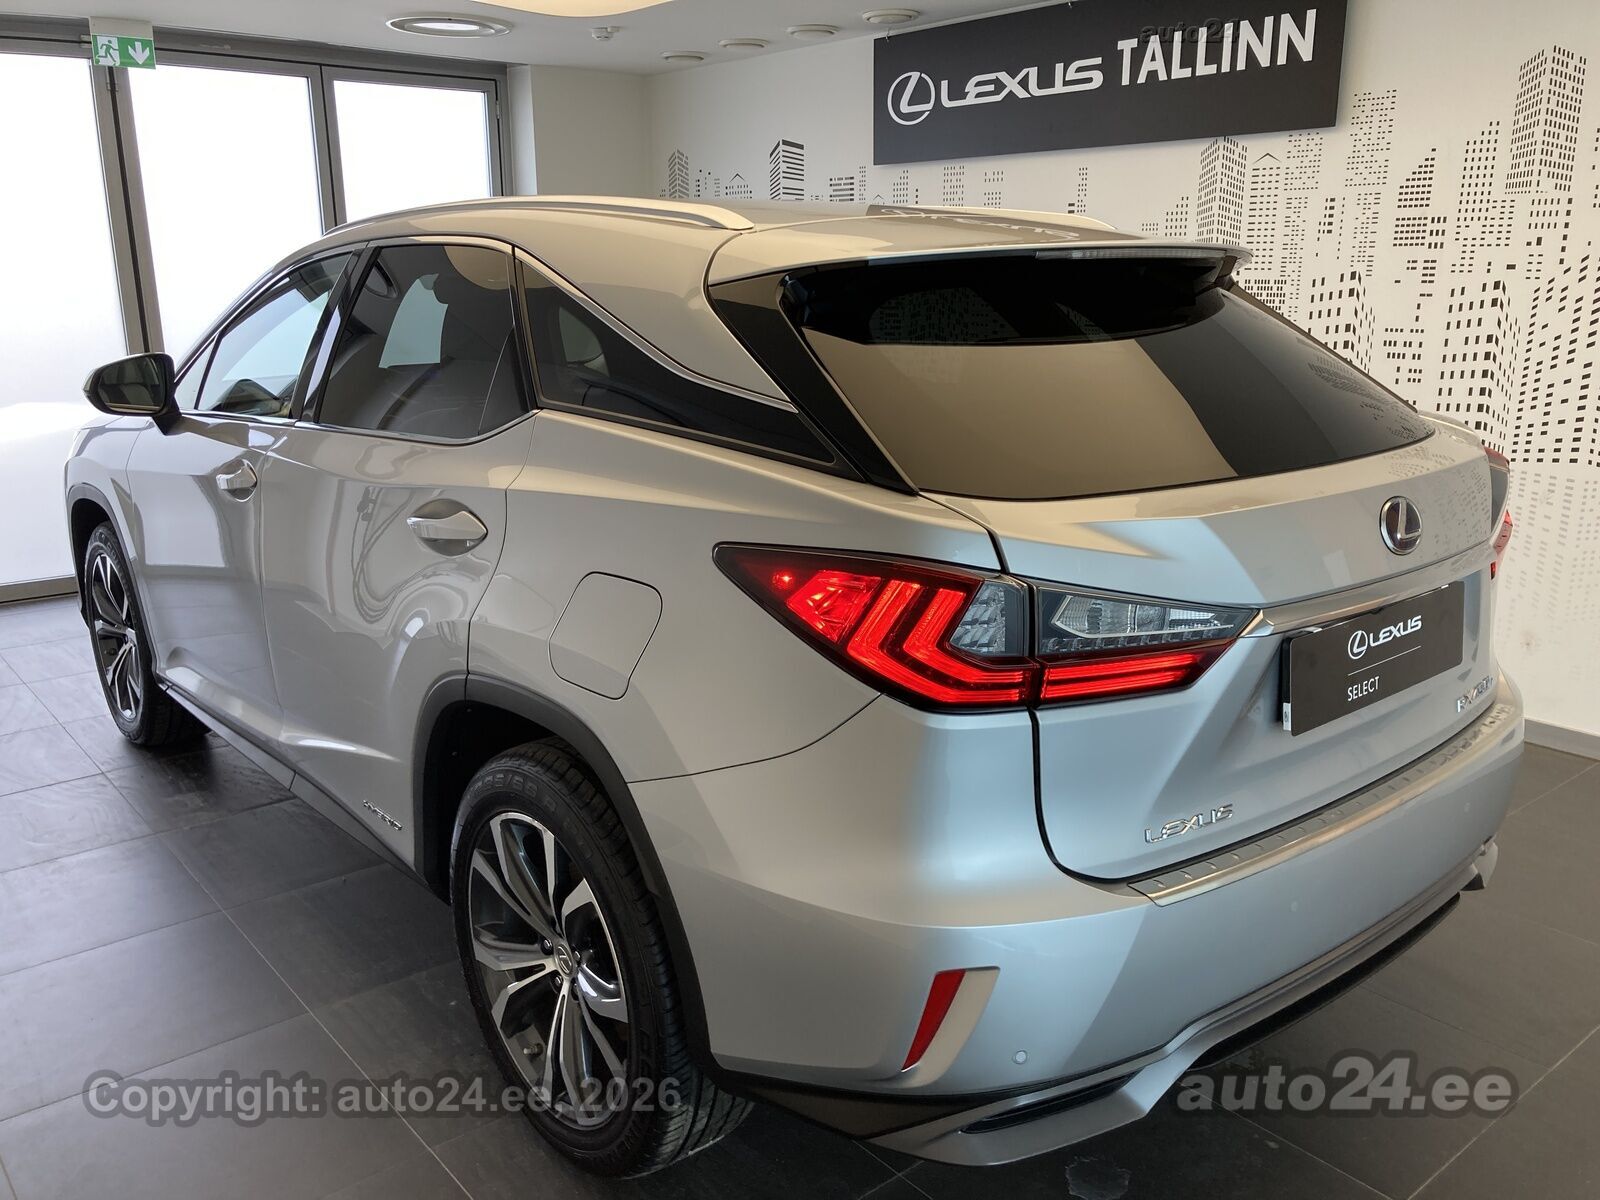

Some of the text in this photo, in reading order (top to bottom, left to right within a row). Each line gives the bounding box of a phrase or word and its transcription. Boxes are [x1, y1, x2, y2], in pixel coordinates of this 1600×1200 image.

[940, 57, 1104, 108] LEXUS
[1117, 8, 1318, 86] TALLINN
[1369, 615, 1422, 647] LEXUS
[1347, 676, 1380, 702] SELECT
[1144, 803, 1233, 844] LEXUS
